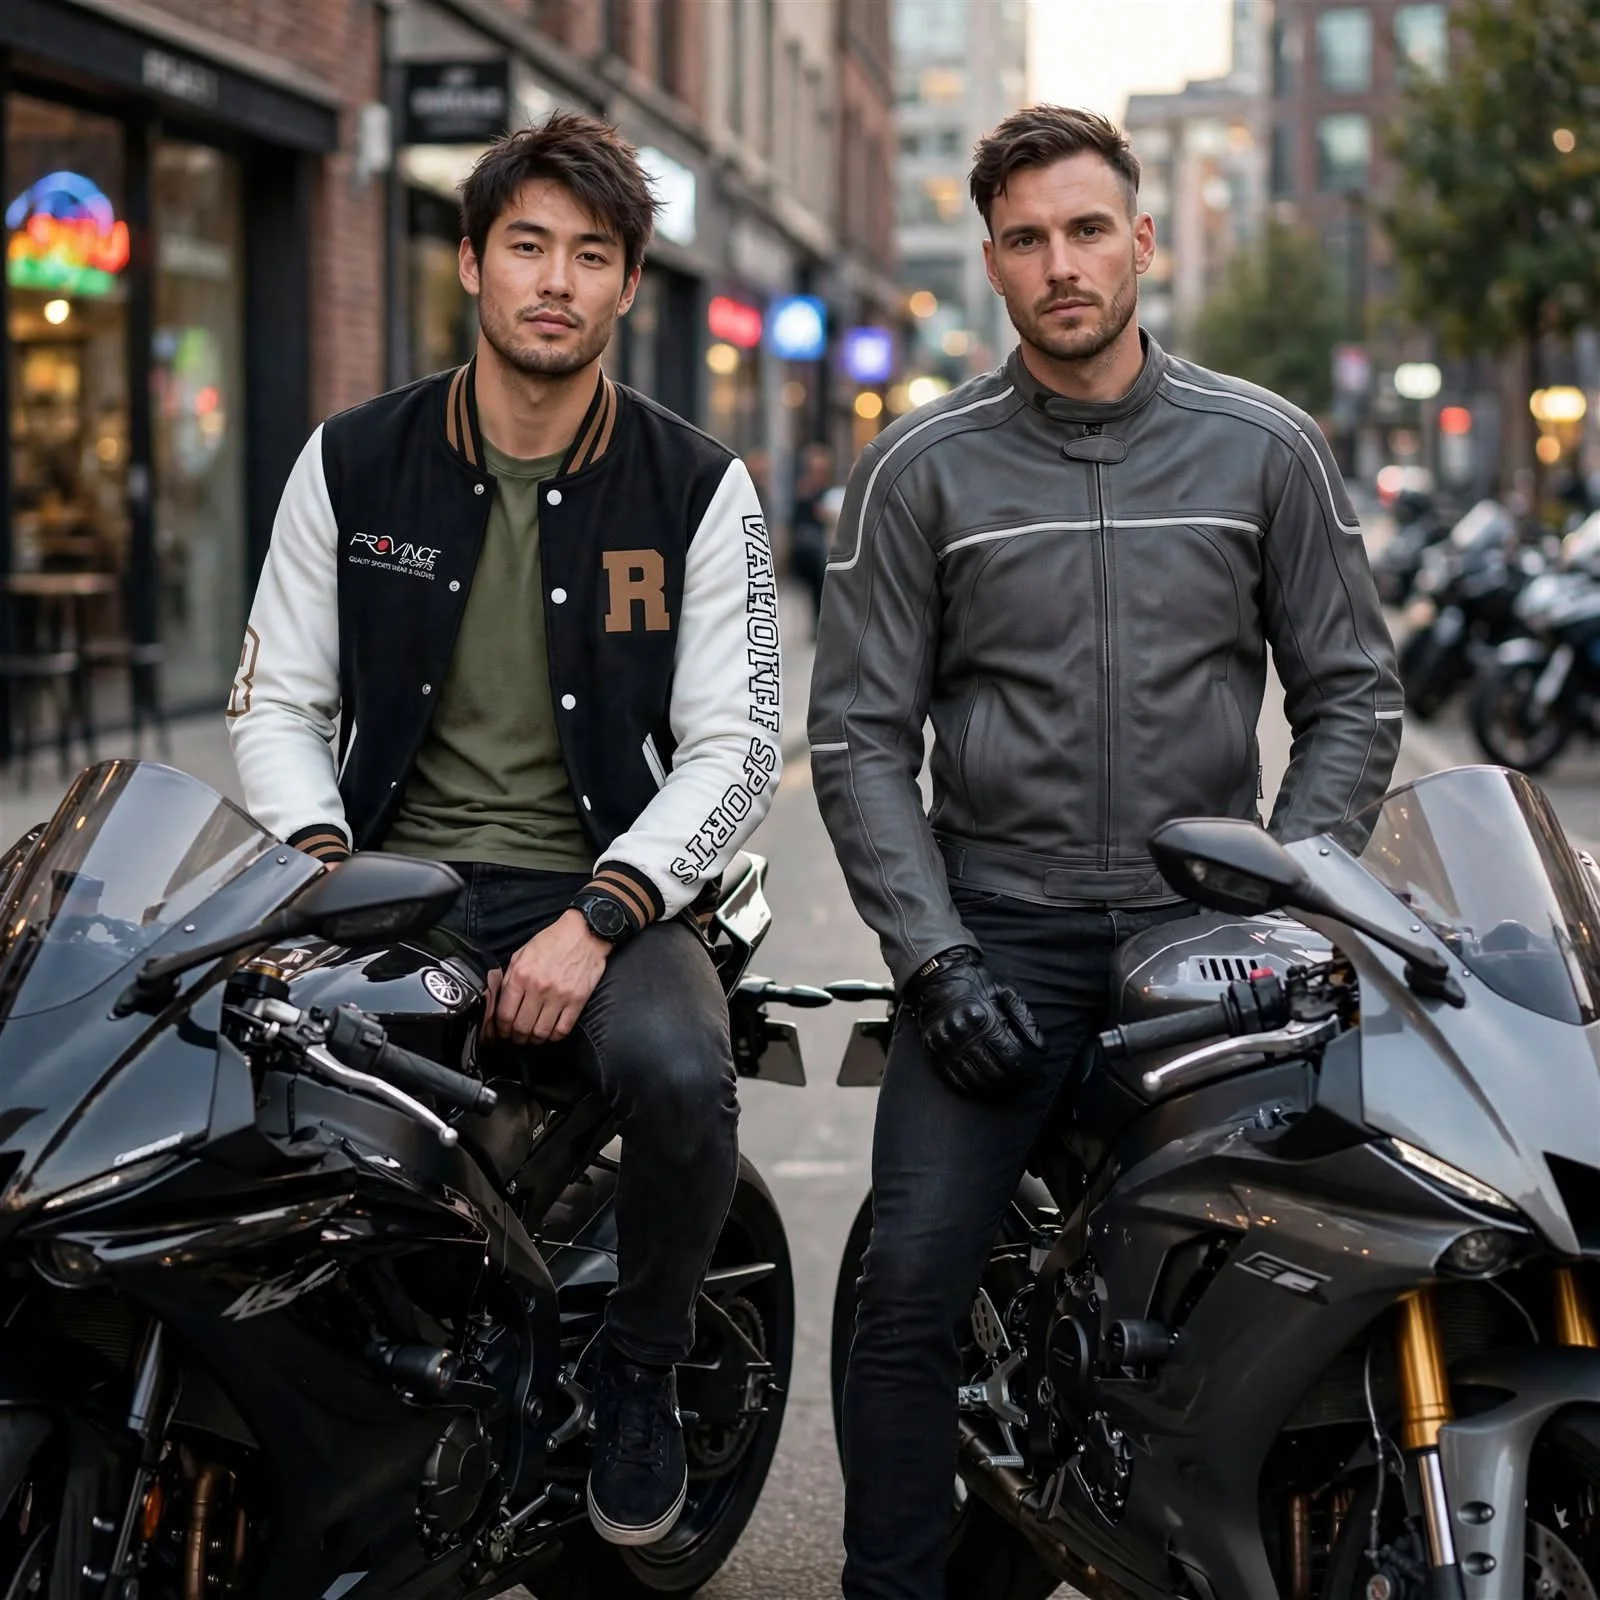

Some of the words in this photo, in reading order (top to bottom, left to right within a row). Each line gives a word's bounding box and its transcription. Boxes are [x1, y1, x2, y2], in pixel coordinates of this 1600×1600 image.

[350, 532, 442, 564] PROVINCE
[399, 557, 434, 571] SPORTS
[349, 555, 371, 565] QUALITY
[413, 570, 435, 581] GLOVES
[602, 548, 671, 633] R
[670, 737, 777, 886] SPORTS
